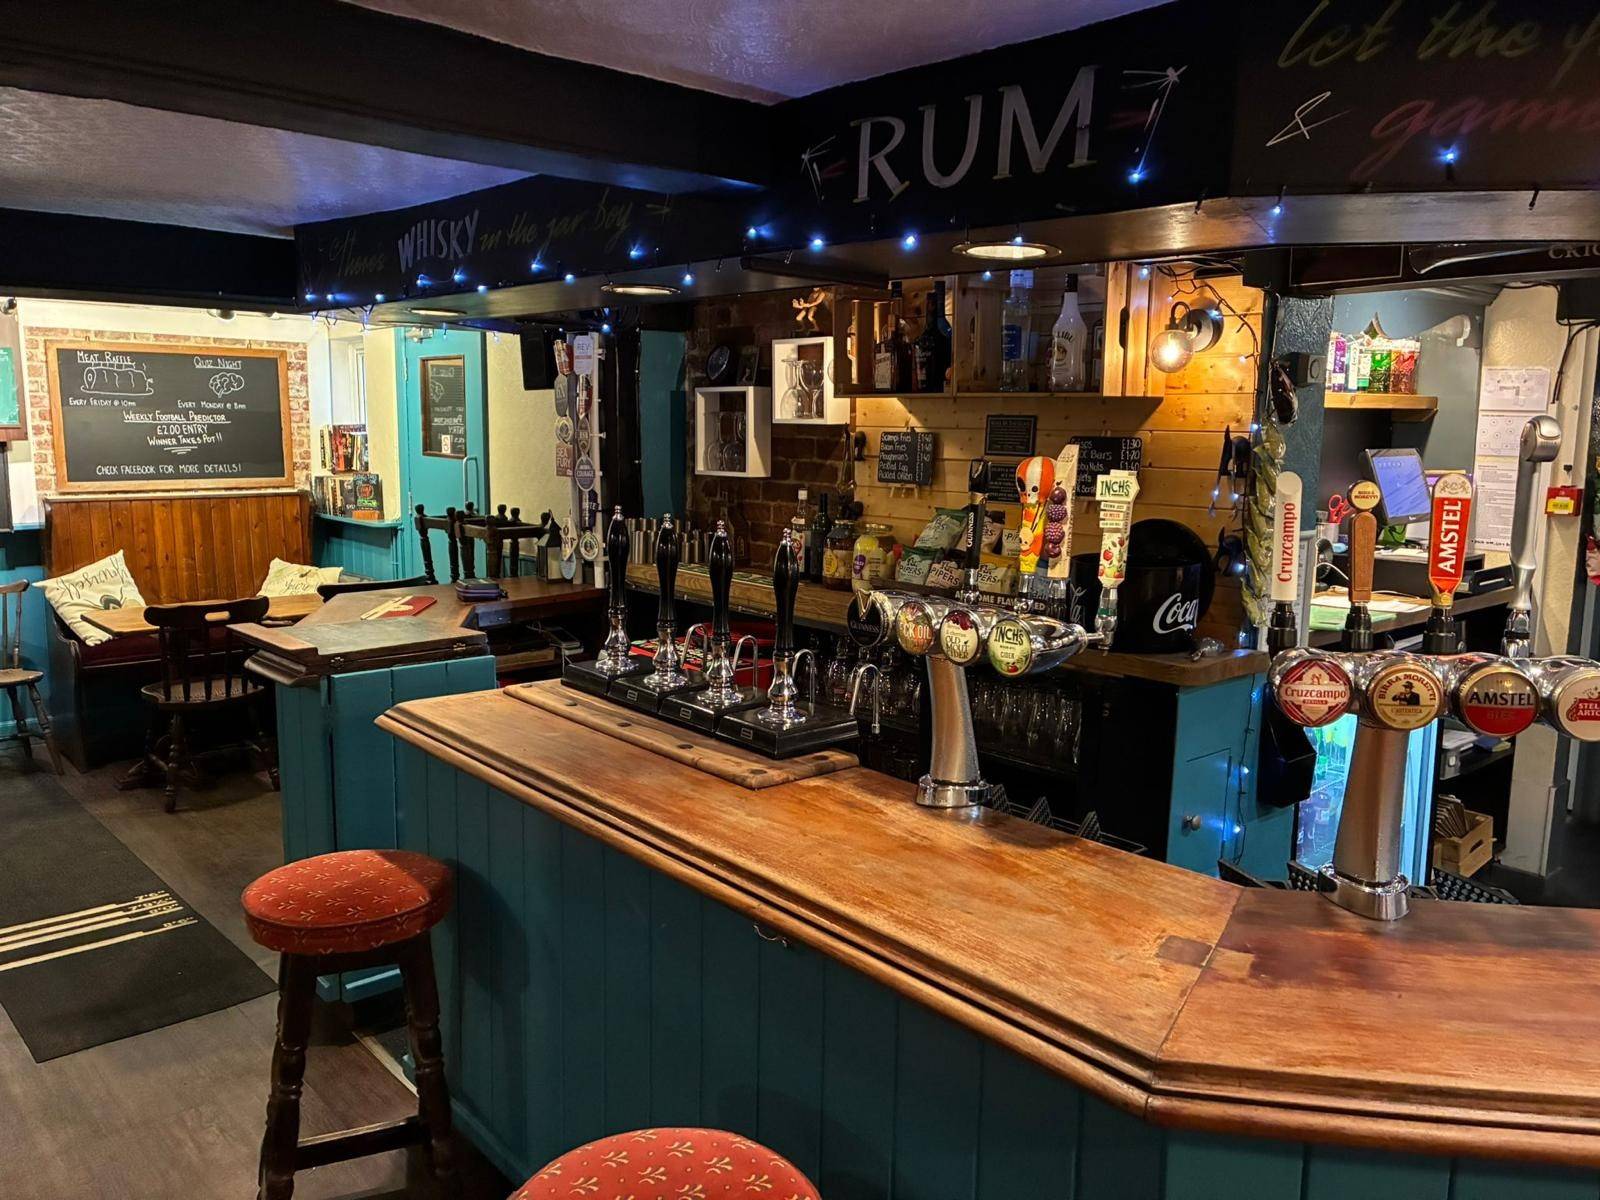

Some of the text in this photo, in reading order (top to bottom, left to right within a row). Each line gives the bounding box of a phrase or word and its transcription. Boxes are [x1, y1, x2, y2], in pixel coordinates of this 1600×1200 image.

[850, 65, 1099, 203] RUM
[398, 210, 479, 273] WHISKY
[506, 211, 538, 246] the
[77, 351, 132, 364] MEAT RAFFLE
[194, 356, 242, 369] QUIZ NIGHT
[69, 397, 87, 406] EVERY
[90, 397, 112, 406] FRIDAY
[177, 400, 196, 408] EVERY
[200, 401, 225, 409] MONDAY
[123, 411, 227, 422] WEEKLY FOOTBALL PREDICTOR
[183, 424, 208, 435] ENTRY
[147, 436, 177, 446] WINNER
[178, 435, 202, 445] TAKES
[1090, 449, 1112, 461] Bars
[96, 465, 118, 475] CHECK
[121, 465, 156, 475] FACEBOOK
[159, 464, 175, 473] FOR
[179, 464, 200, 473] MORE
[1089, 461, 1105, 472] Nuts
[966, 512, 975, 547] GUINNESS
[1277, 502, 1298, 583] Cruzcampo
[1438, 500, 1462, 574] AMSTEL
[899, 565, 922, 577] PIPERS
[930, 567, 960, 586] PIPERS
[917, 625, 932, 640] OIL
[945, 636, 961, 645] OLD
[1285, 686, 1347, 700] Cruzcampo
[1378, 674, 1437, 701] BIRRA MORETTI
[1468, 691, 1535, 706] AMSTEL
